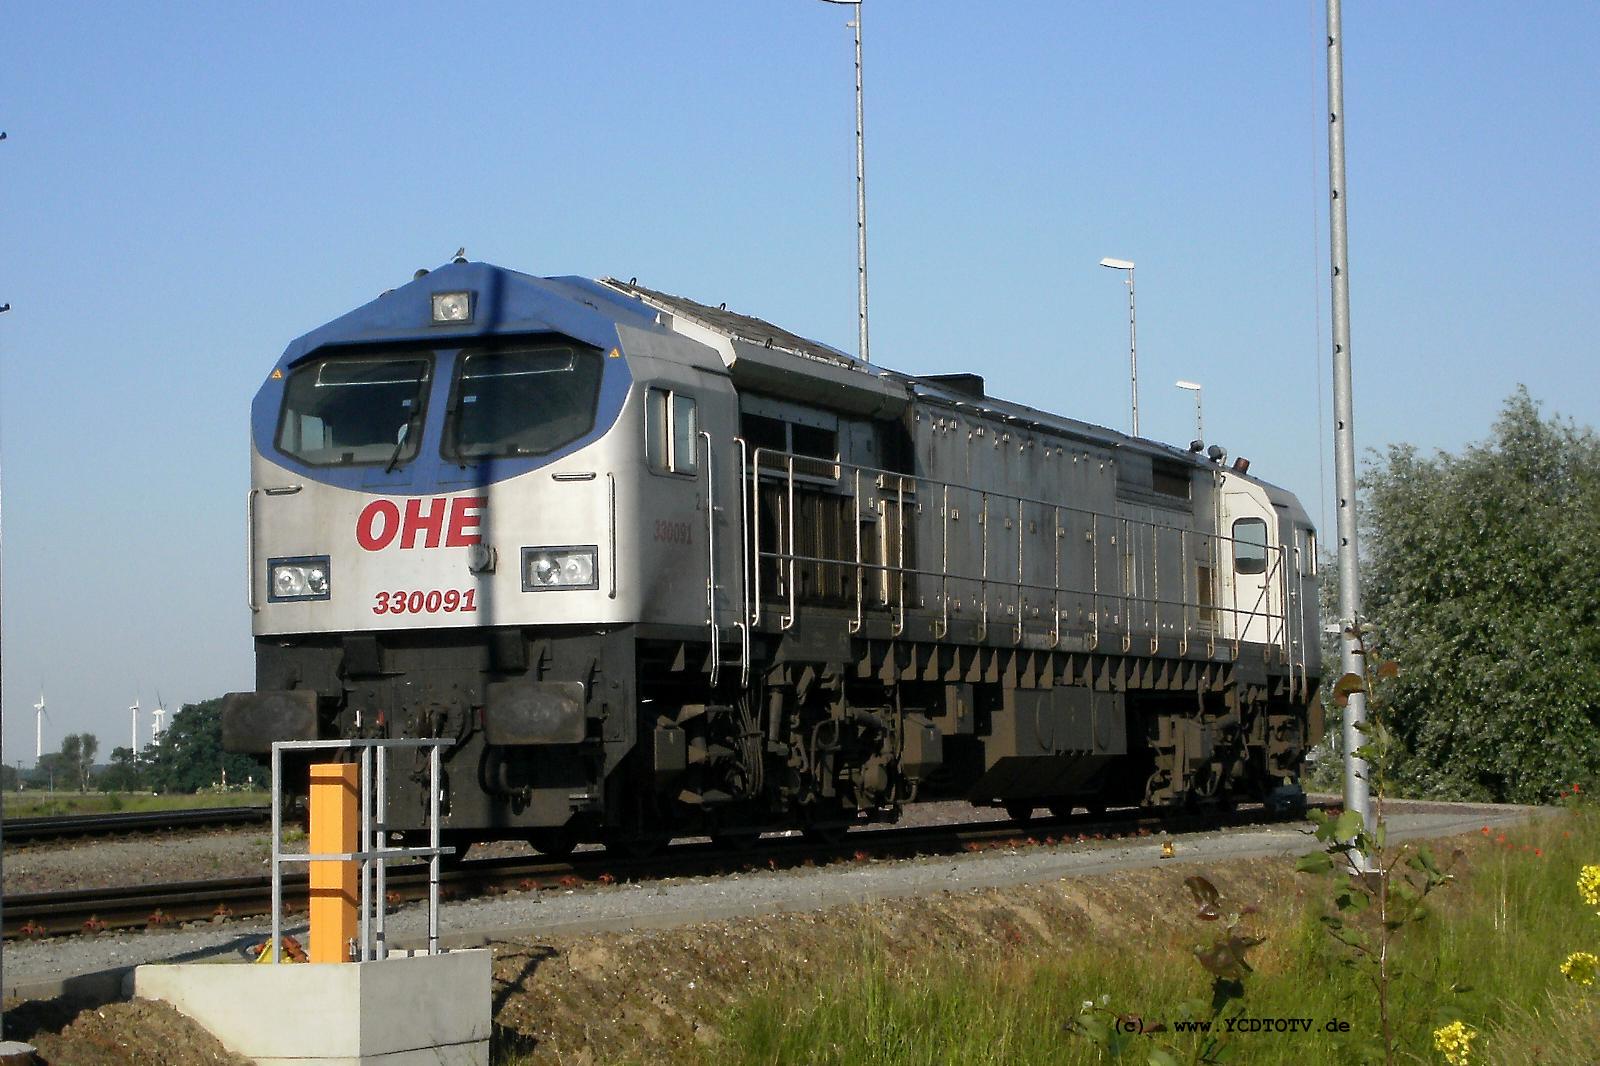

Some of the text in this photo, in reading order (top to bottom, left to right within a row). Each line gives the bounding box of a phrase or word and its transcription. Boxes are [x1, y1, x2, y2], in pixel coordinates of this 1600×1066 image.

[355, 497, 489, 552] OHE
[653, 518, 693, 545] 330091
[372, 589, 478, 615] 330091
